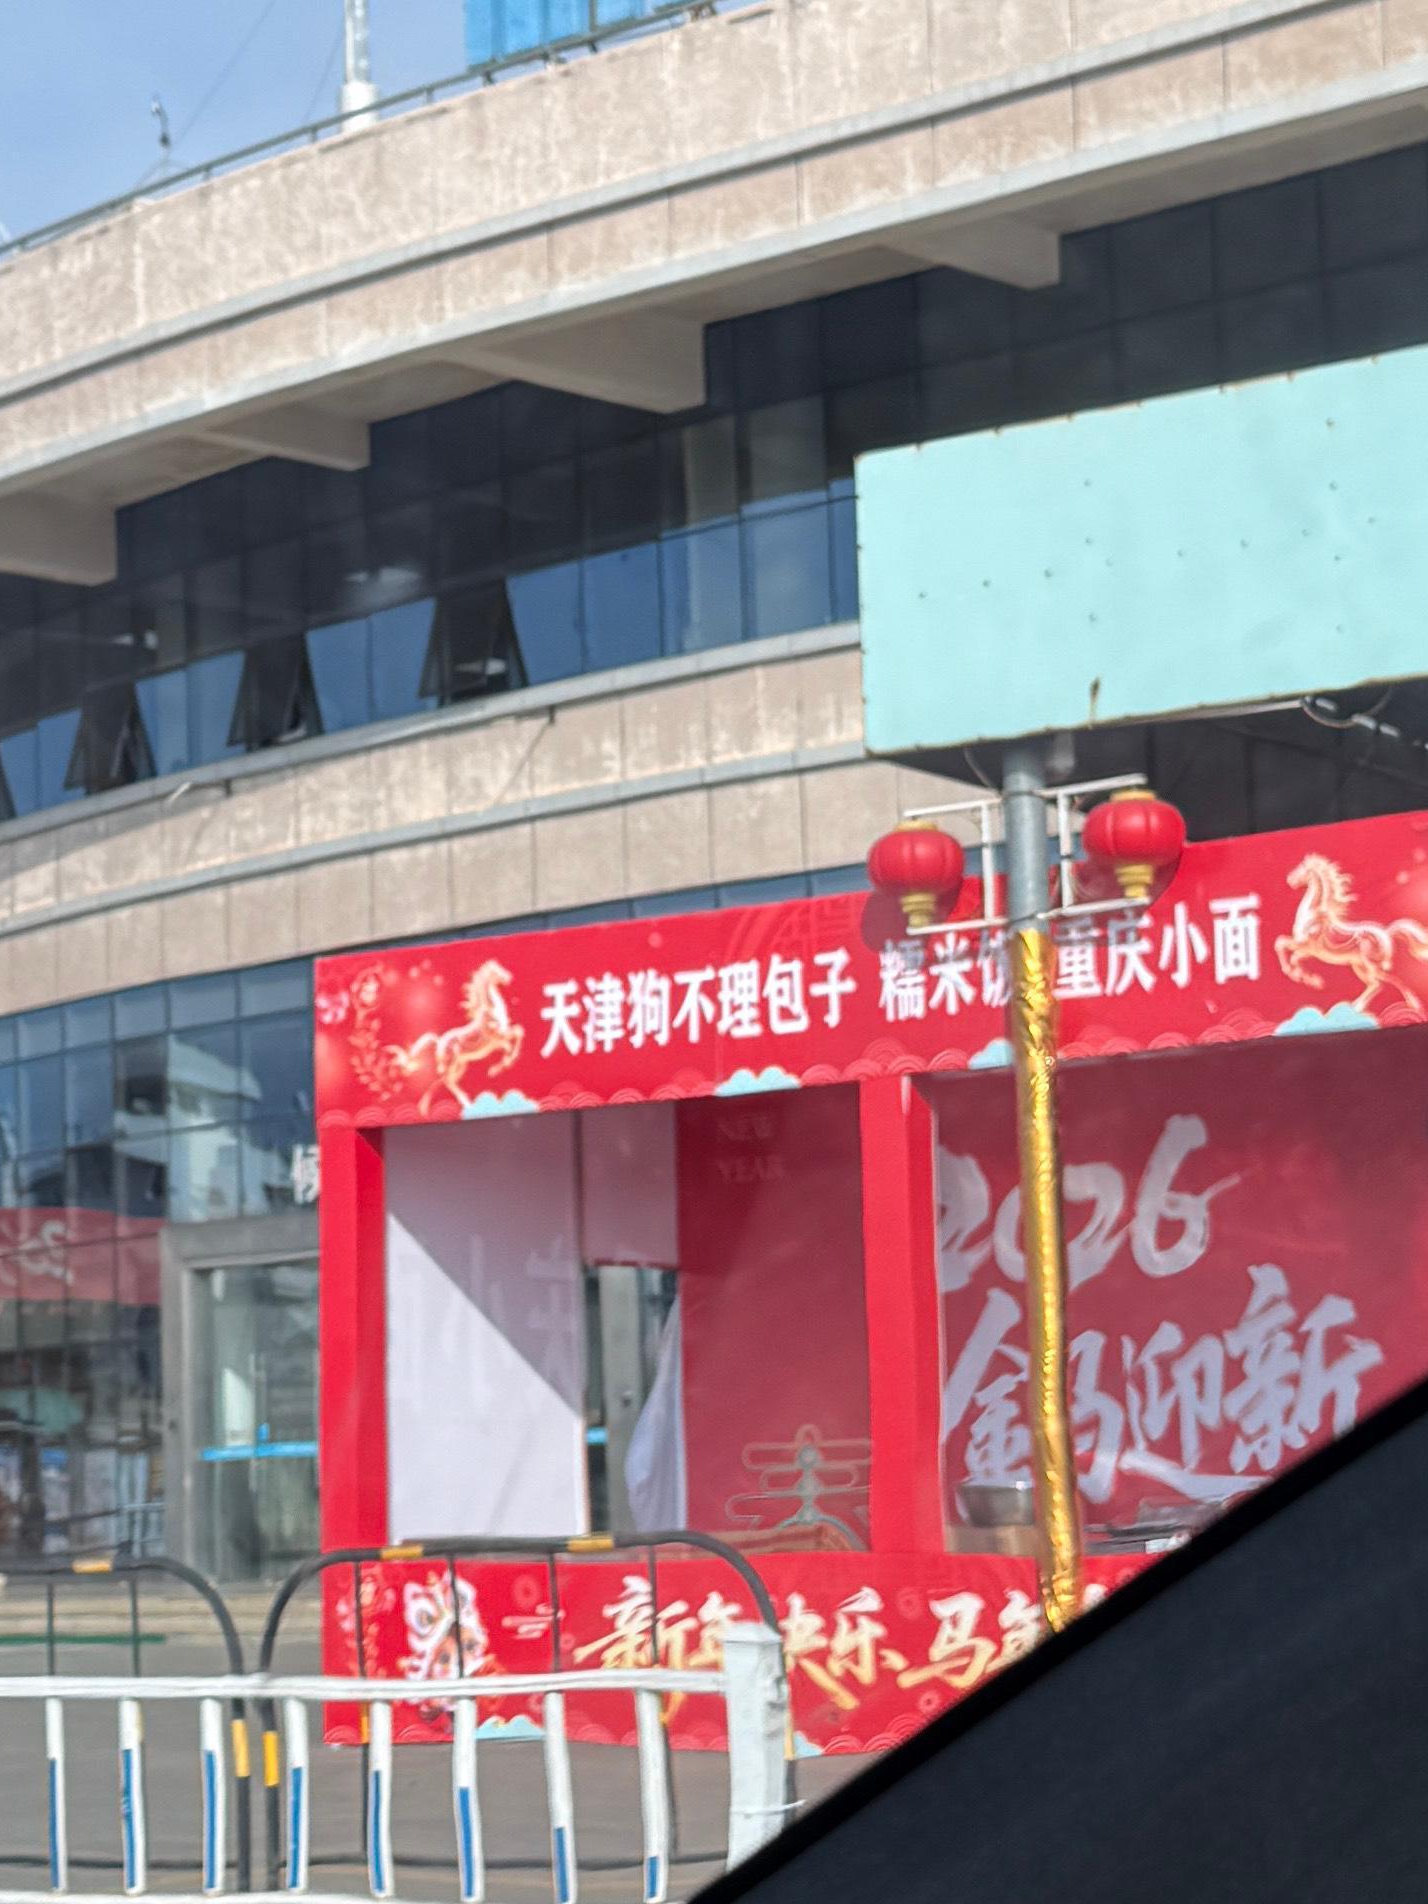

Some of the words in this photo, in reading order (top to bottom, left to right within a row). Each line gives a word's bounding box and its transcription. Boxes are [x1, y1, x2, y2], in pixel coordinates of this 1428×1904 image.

[540, 946, 857, 1059] 天津狗不理包子
[1053, 893, 1262, 1000] 重庆小面
